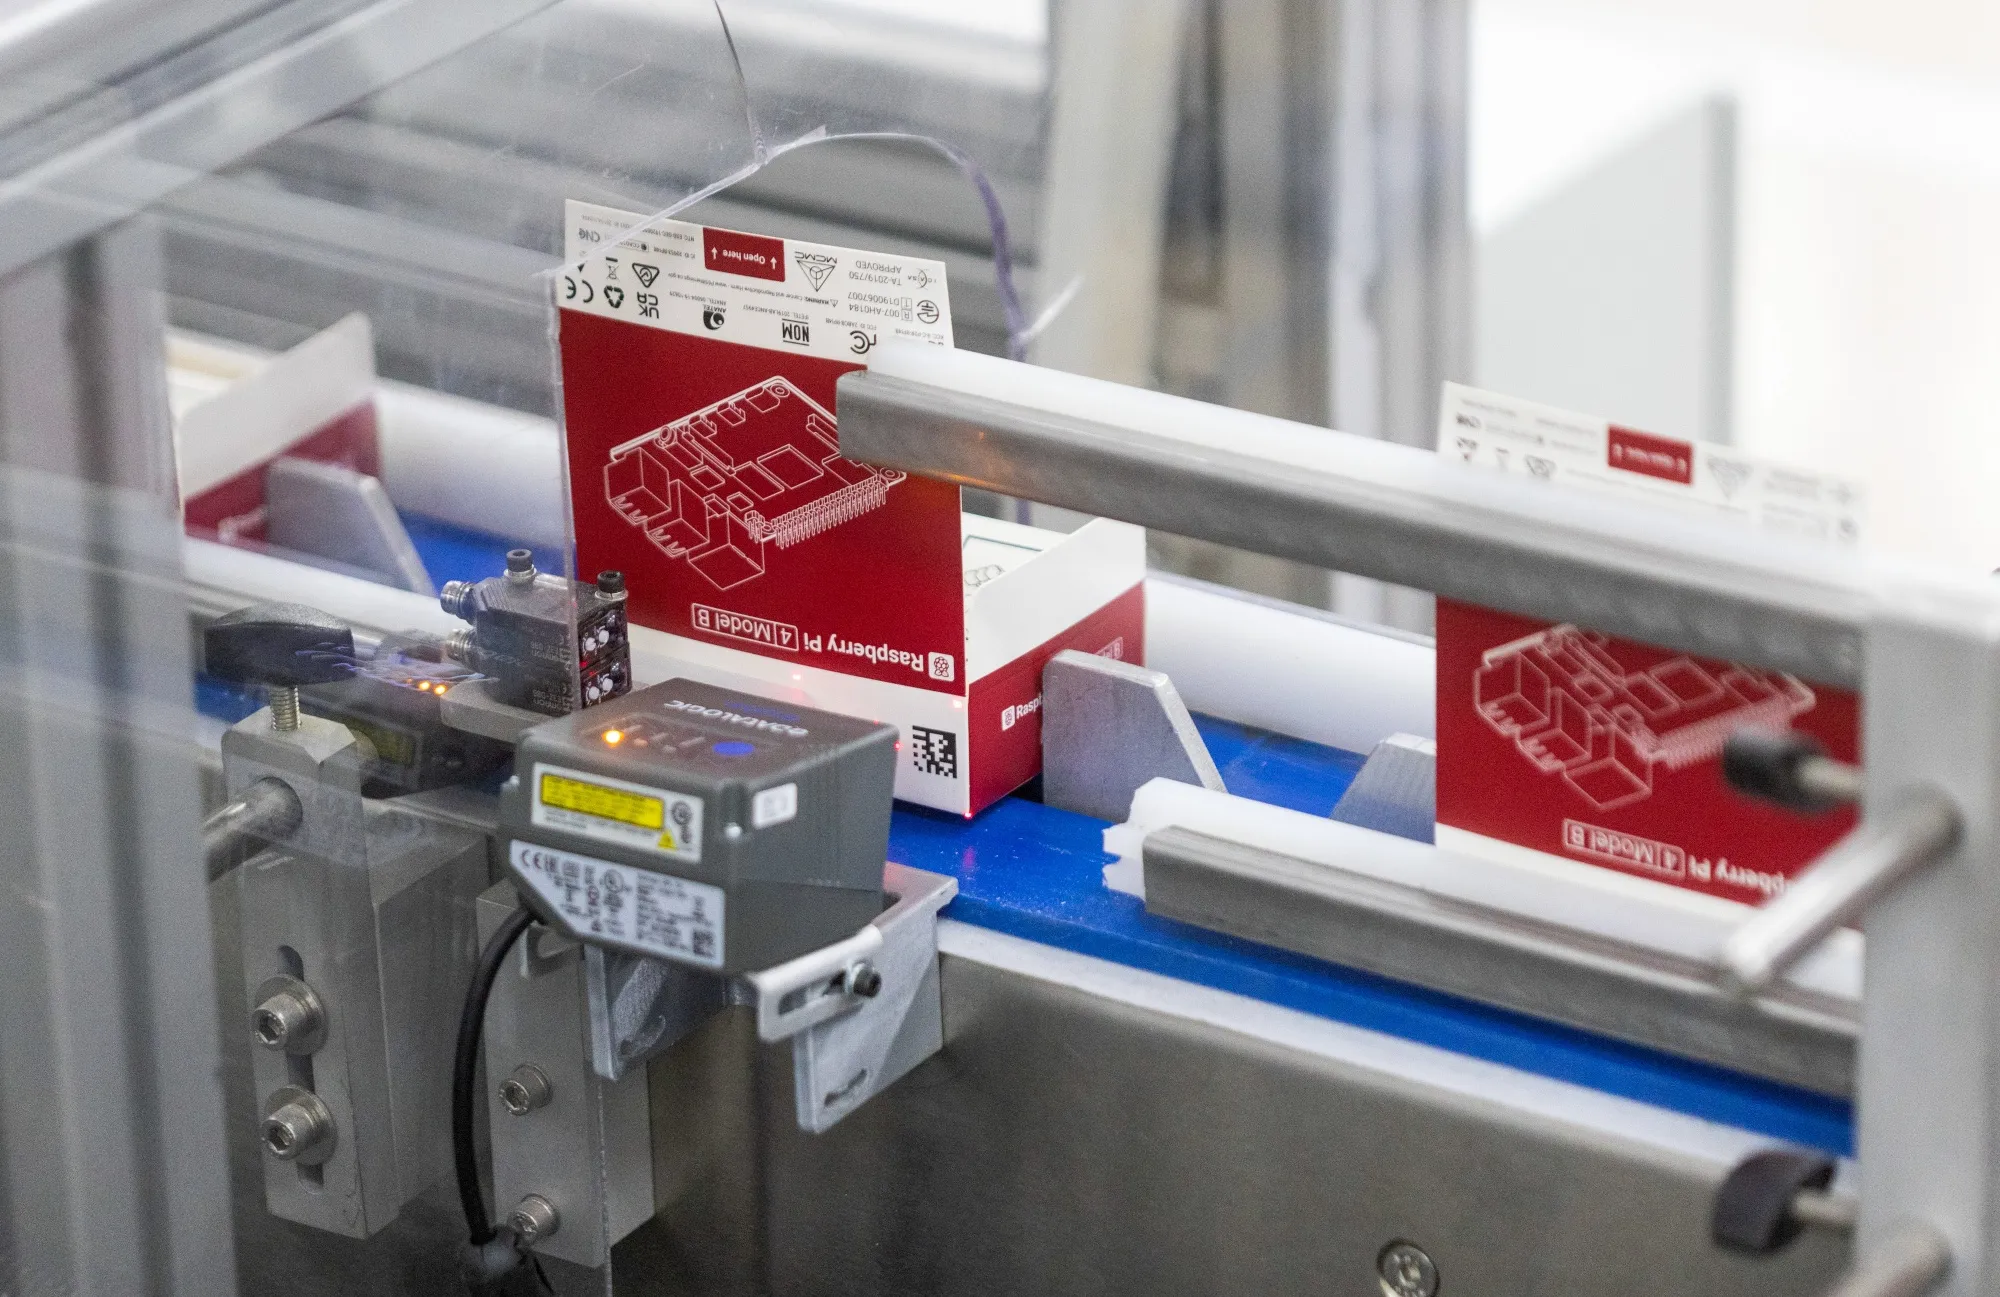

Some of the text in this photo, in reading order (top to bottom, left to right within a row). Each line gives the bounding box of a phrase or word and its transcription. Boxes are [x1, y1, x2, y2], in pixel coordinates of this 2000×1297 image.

[722, 249, 765, 264] Open here
[794, 251, 837, 263] MCMC
[855, 259, 901, 273] APPROVED
[848, 270, 901, 285] TA-2019/750
[563, 275, 594, 304] CE
[636, 291, 658, 306] CA
[847, 290, 899, 306] D190067007
[638, 304, 659, 319] UK
[702, 304, 726, 313] ANATEL
[848, 302, 899, 317] 007-AH0184
[782, 322, 809, 342] NOM
[698, 608, 925, 672] Raspberry Pi 4 Model B
[664, 699, 799, 737] DATALOGIC
[1570, 825, 1585, 846] B
[1590, 830, 1655, 865] Model
[1664, 850, 1679, 869] 4
[1687, 855, 1712, 882] Pi
